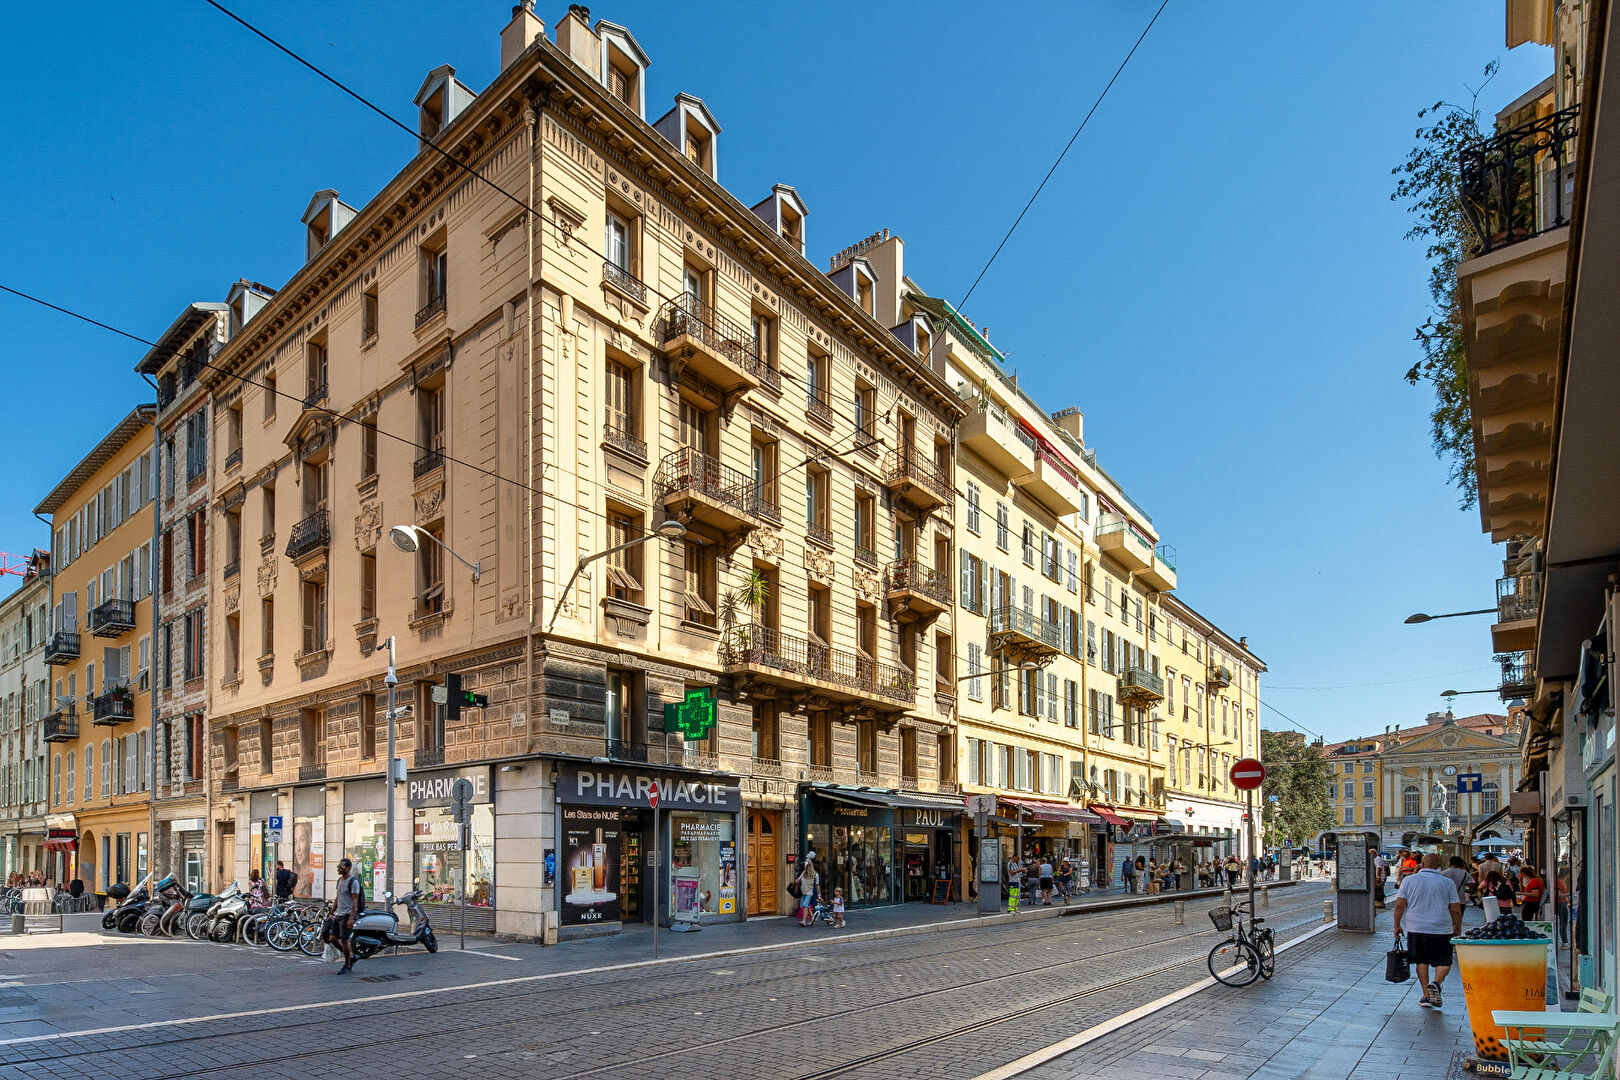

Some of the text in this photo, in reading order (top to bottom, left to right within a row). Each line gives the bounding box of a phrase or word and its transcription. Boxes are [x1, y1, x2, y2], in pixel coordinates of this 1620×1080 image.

[410, 774, 485, 800] PHARMIE
[577, 770, 727, 805] PHARMACIE
[564, 809, 620, 821] Les Stars de NUXE
[915, 809, 944, 827] PAUL
[272, 818, 279, 828] P
[422, 843, 435, 851] PRIX
[435, 843, 446, 851] BAS
[581, 912, 602, 920] NUXE
[1476, 1062, 1511, 1075] Bubble
